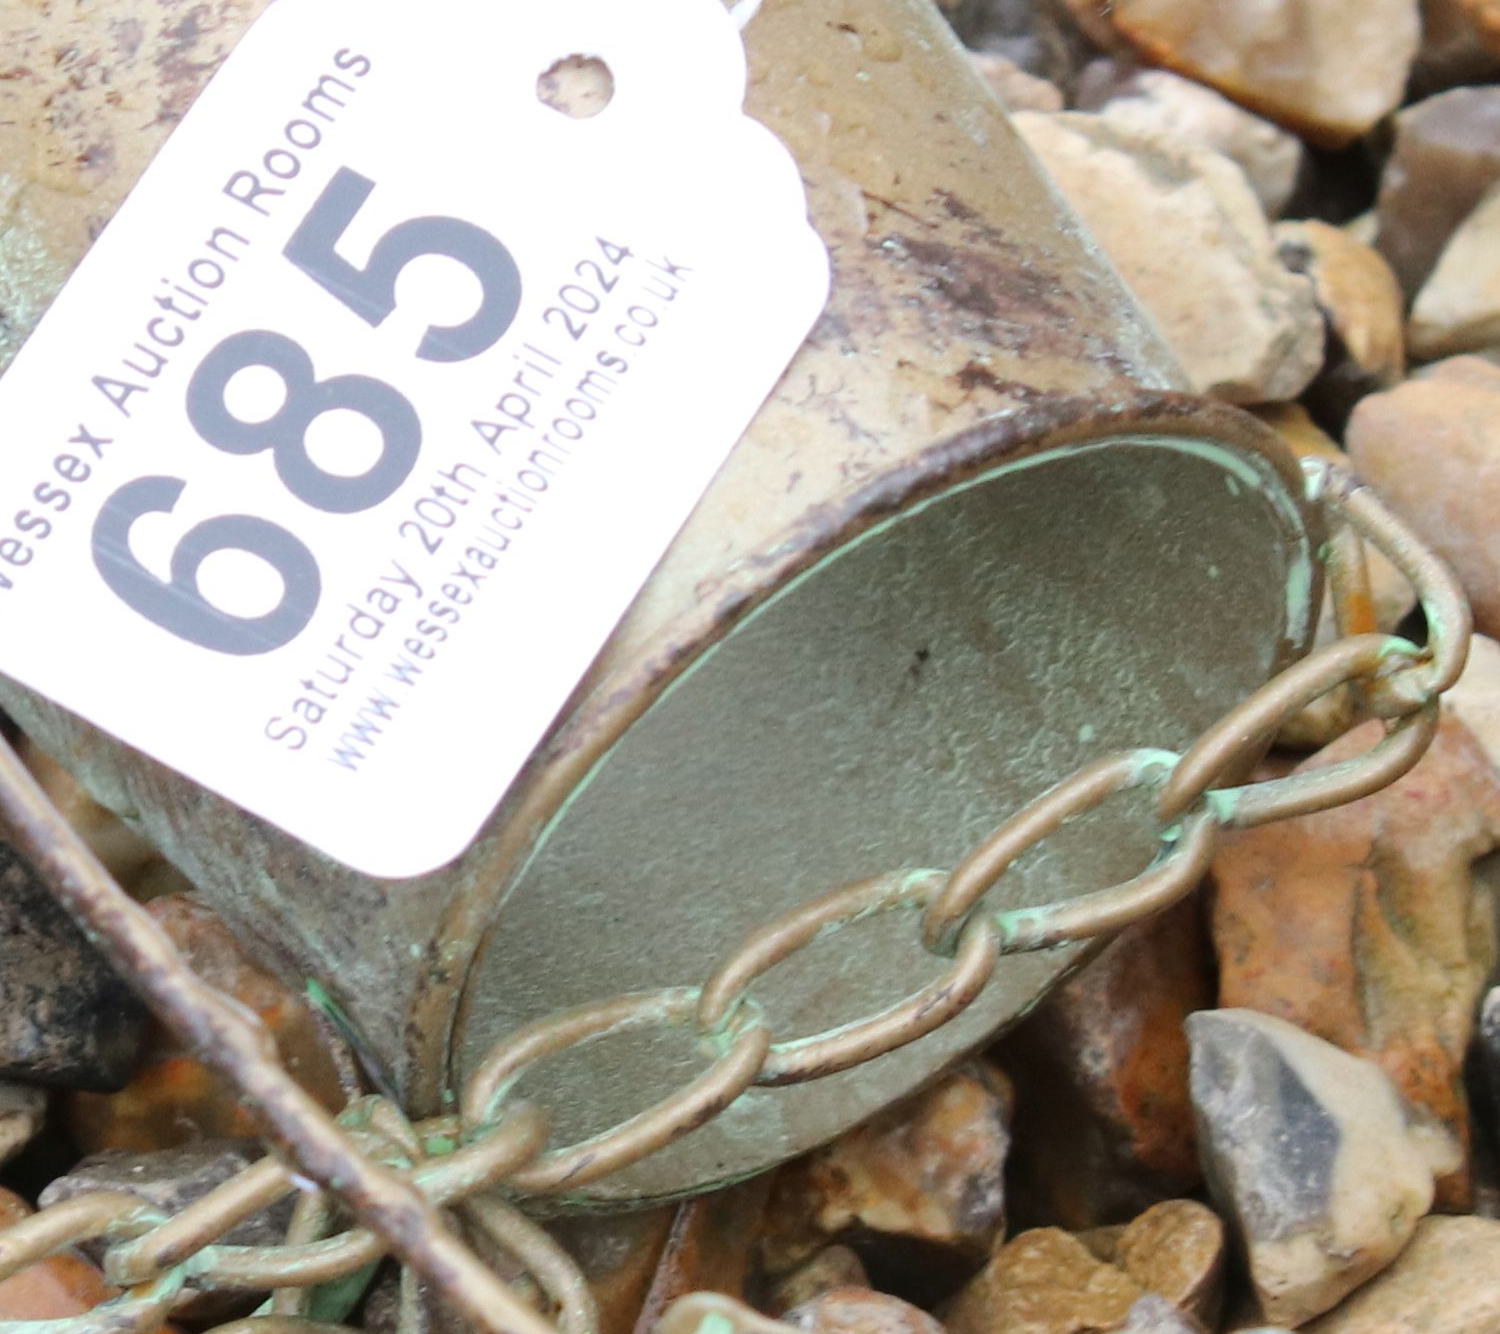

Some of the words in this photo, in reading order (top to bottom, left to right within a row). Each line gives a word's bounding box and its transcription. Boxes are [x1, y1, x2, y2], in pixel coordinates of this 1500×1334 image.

[90, 226, 251, 418] Auction
[221, 47, 371, 217] Rooms
[90, 165, 523, 657] 685
[264, 560, 424, 751] Saturday
[398, 463, 487, 555] 20th
[470, 343, 562, 455] April
[542, 236, 634, 342] 2024
[328, 256, 692, 771] www.wessexauctionrooms.co.uk
